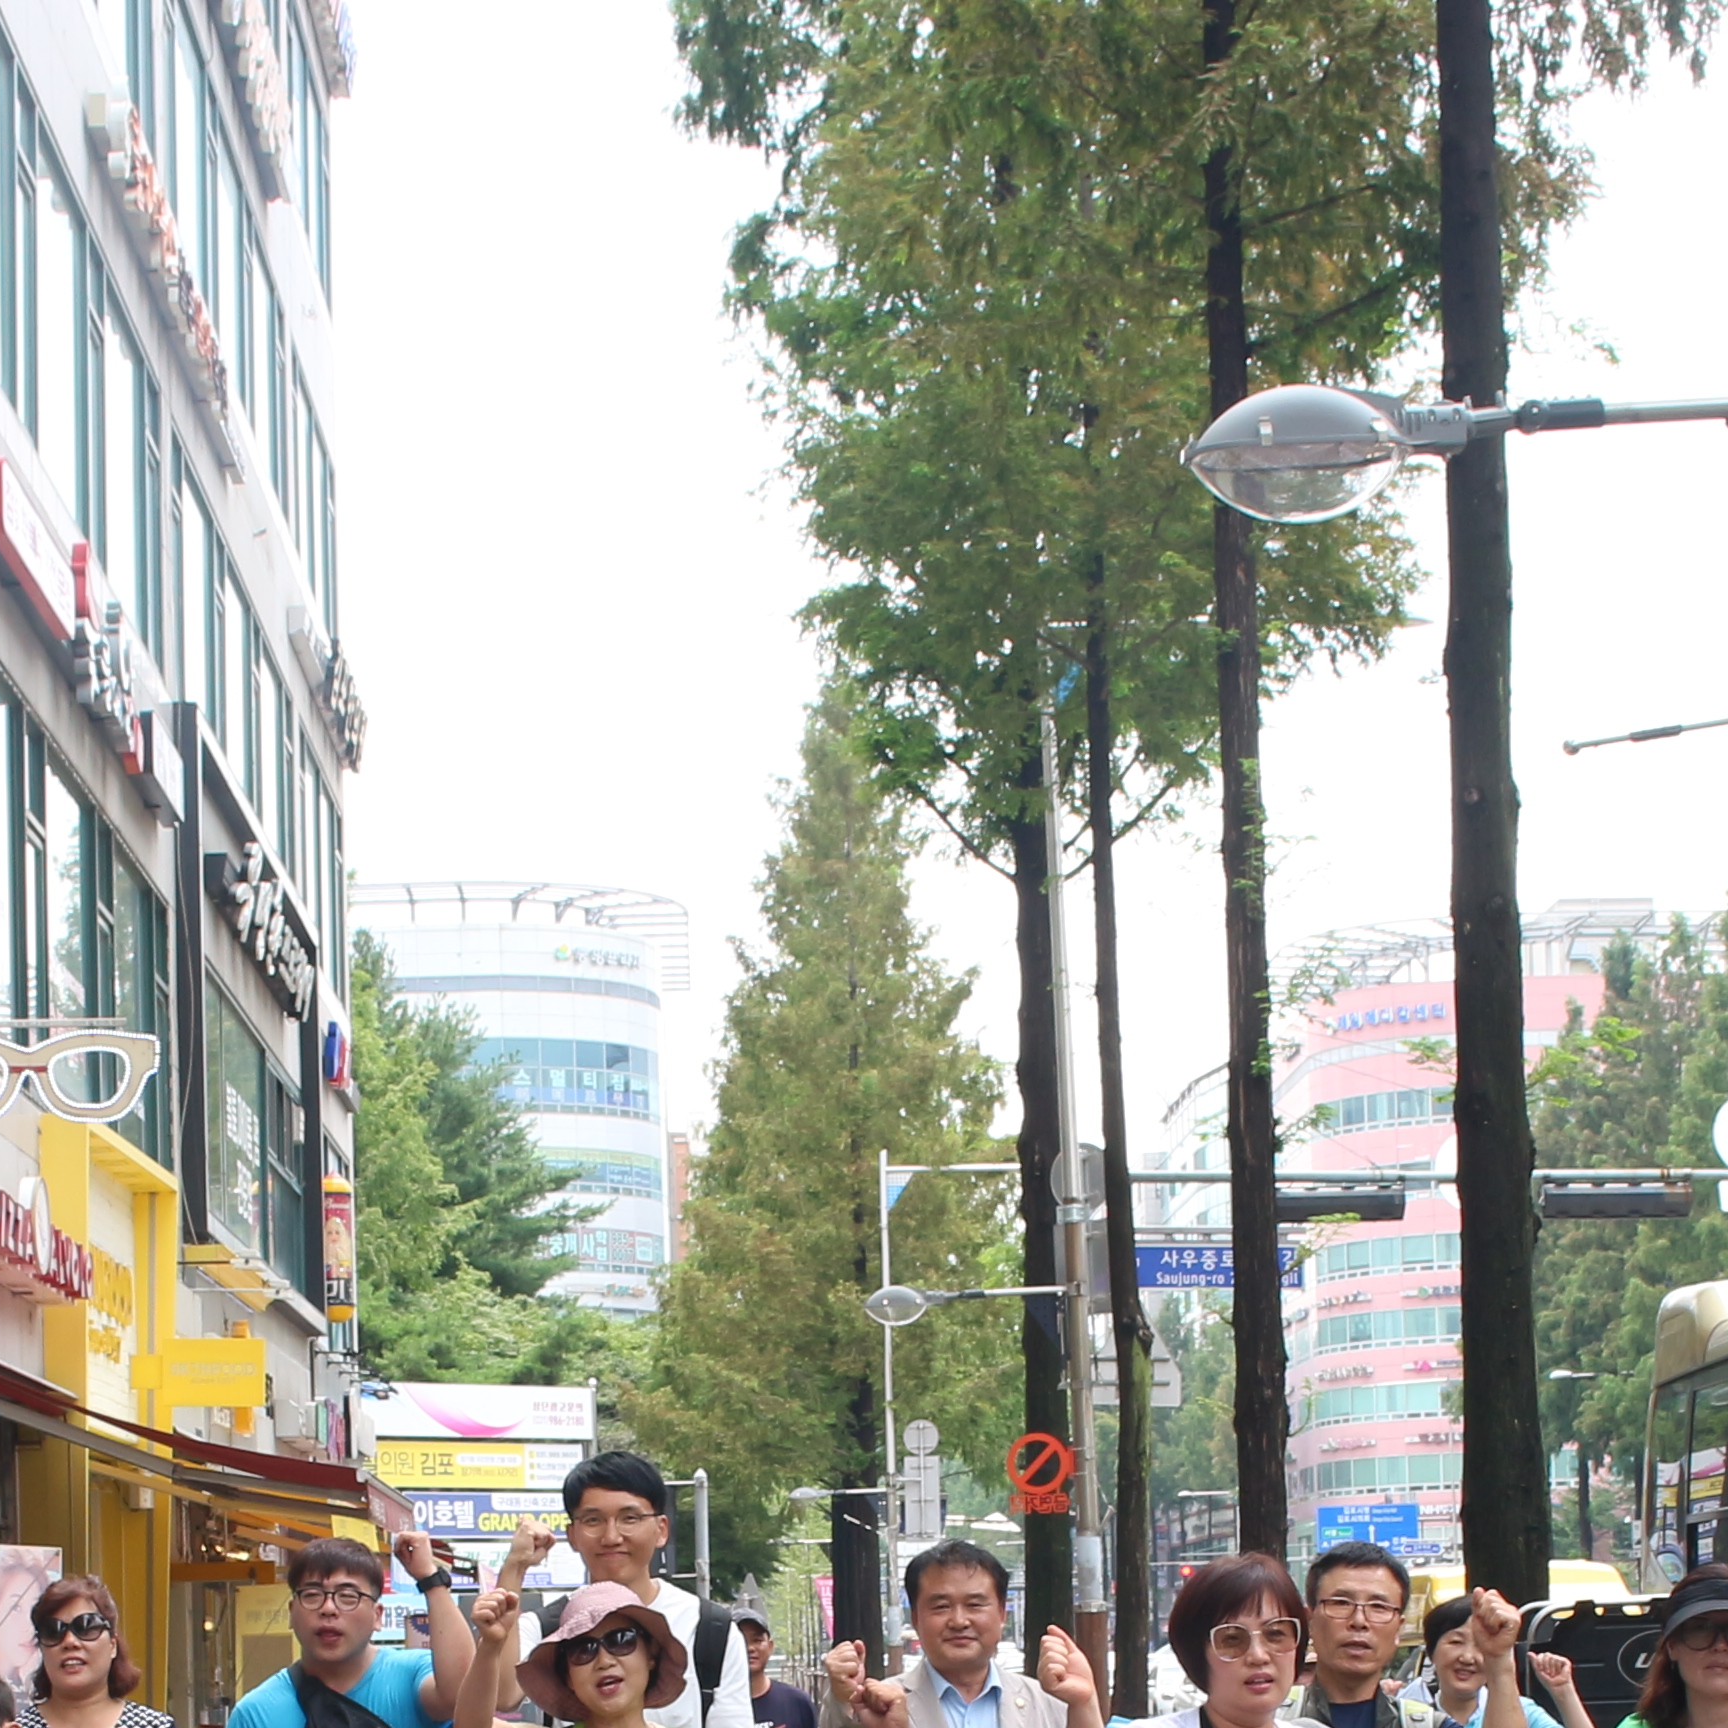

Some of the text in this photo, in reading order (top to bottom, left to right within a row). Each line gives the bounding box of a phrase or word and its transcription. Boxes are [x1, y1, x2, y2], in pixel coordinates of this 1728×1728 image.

[1160, 1248, 1234, 1271] 사우중로
[1156, 1271, 1225, 1286] Saujung-ro
[419, 1452, 455, 1476] 김포
